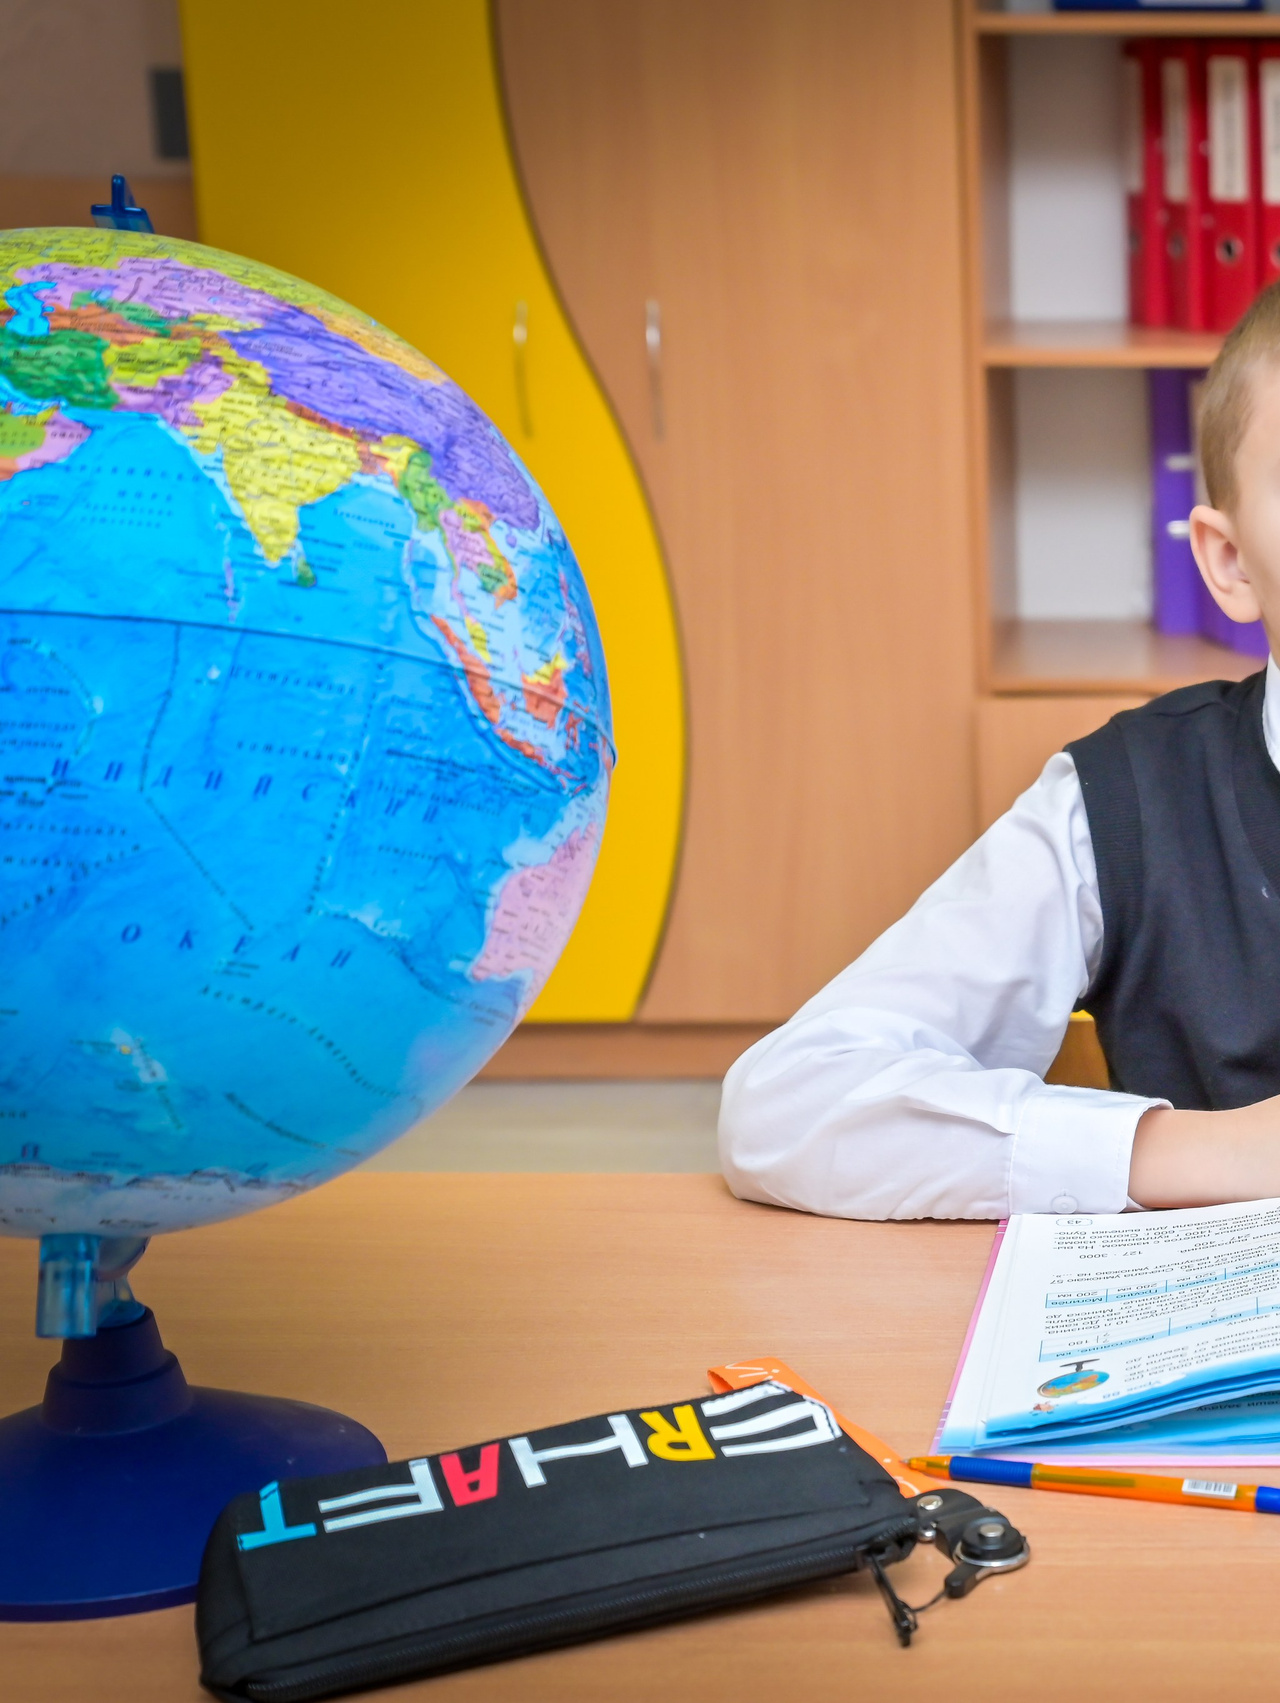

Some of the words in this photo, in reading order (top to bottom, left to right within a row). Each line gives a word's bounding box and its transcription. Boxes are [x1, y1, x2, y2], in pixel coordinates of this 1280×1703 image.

[120, 922, 353, 971] ОКЕАН
[1095, 1267, 1149, 1275] умножаю
[1067, 1274, 1120, 1282] умножаю
[1116, 1289, 1158, 1298] Гродно
